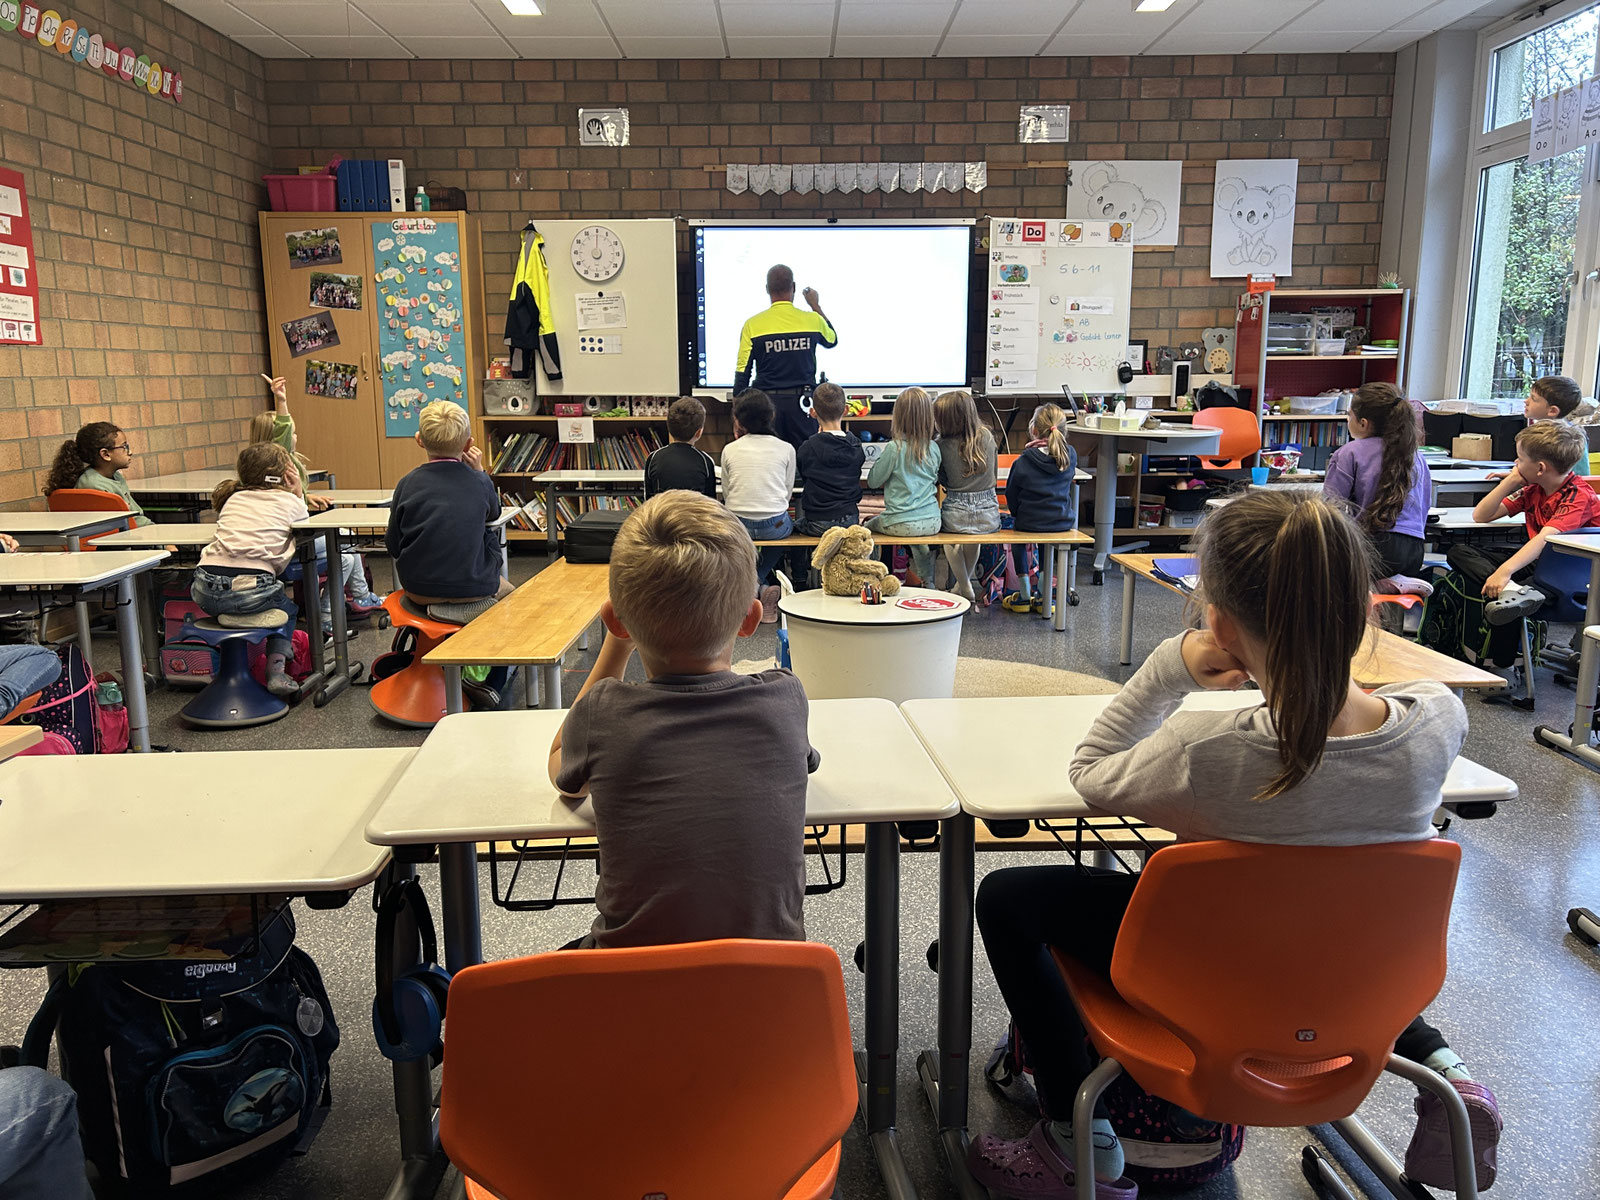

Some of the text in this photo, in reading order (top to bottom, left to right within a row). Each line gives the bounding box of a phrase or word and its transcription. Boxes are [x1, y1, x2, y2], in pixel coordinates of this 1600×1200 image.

[0, 1, 16, 22] Oo
[43, 16, 58, 42] Qq
[63, 27, 72, 44] Rr
[104, 47, 118, 68] Uu
[122, 55, 134, 73] Vv
[1535, 141, 1548, 151] Oo
[1584, 128, 1597, 140] Aa
[1027, 227, 1042, 237] Do
[1079, 318, 1090, 327] AB
[764, 337, 811, 353] POLIZEI
